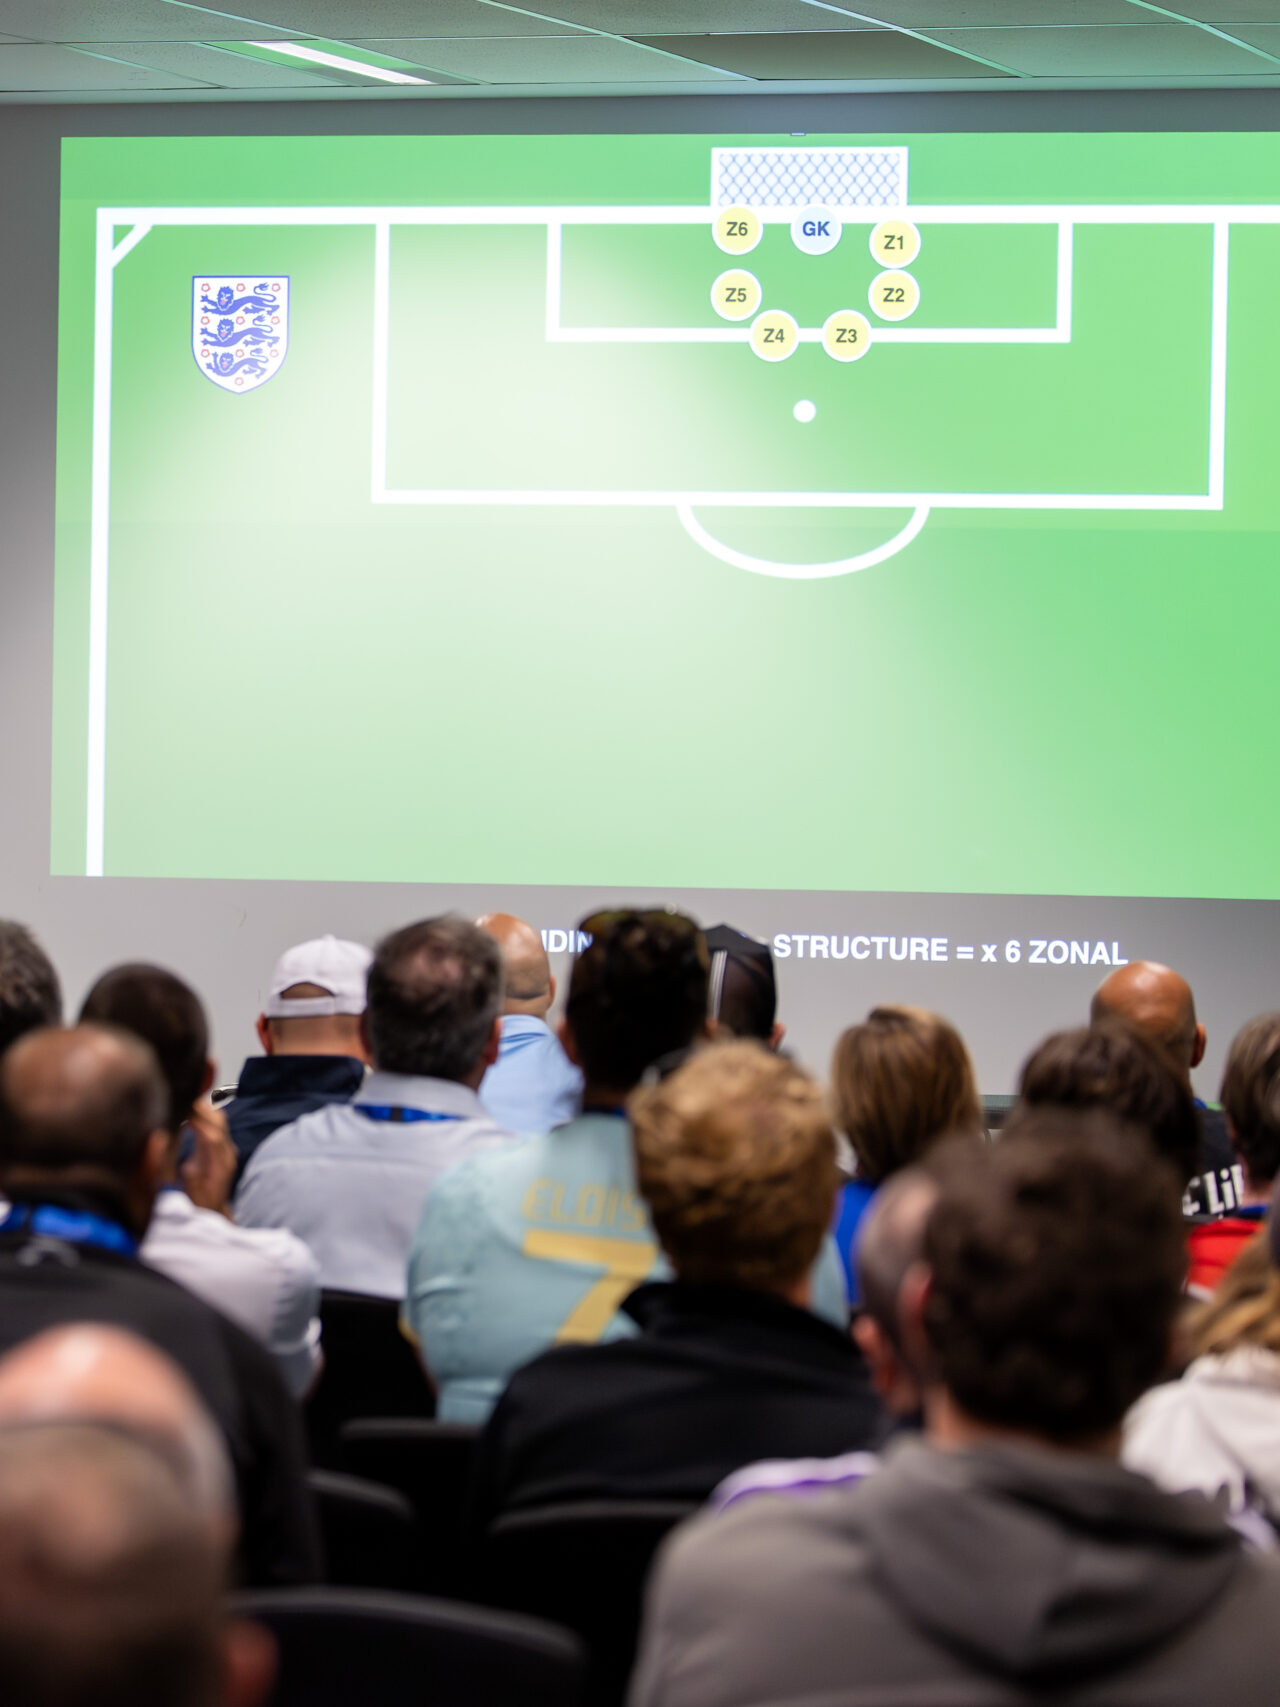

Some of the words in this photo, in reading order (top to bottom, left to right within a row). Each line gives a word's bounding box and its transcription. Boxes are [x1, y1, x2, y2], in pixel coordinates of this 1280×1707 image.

[726, 221, 748, 237] Z6
[802, 221, 830, 237] GK
[883, 235, 904, 250] Z1
[725, 288, 747, 303] Z5
[883, 288, 905, 303] Z2
[763, 328, 785, 343] Z4
[836, 328, 857, 343] Z3
[773, 933, 948, 962] STRUCTURE
[956, 945, 974, 960] =
[980, 943, 998, 963] x
[1005, 939, 1021, 963] 6
[1028, 939, 1129, 966] ZONAL
[523, 1228, 659, 1346] 7
